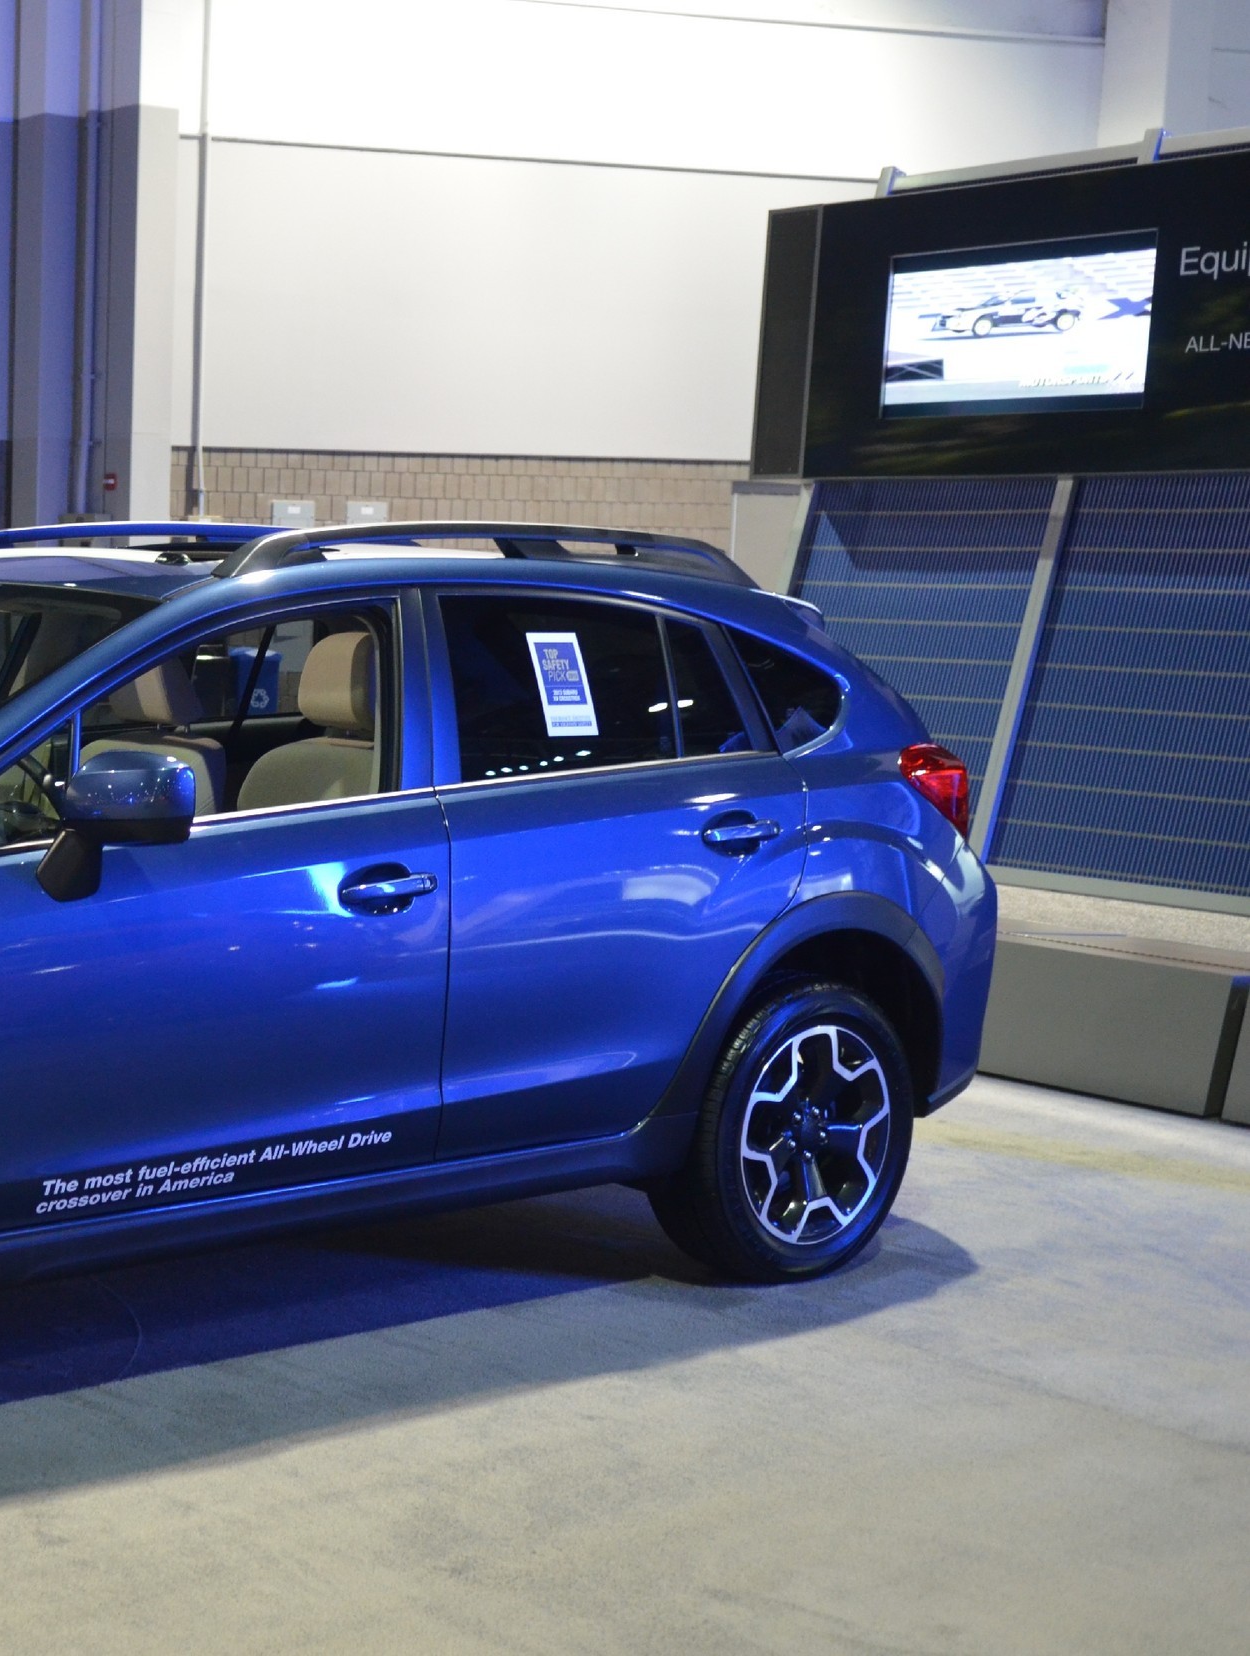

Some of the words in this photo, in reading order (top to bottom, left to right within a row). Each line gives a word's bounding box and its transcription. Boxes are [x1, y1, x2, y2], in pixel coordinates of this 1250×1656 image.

[1180, 241, 1250, 281] Equi
[1185, 332, 1250, 354] ALL-NE
[542, 659, 569, 670] SAFETY
[543, 649, 558, 659] TOP
[43, 1179, 79, 1196] The
[84, 1169, 133, 1190] most
[137, 1150, 256, 1182] fuel-efficient
[259, 1135, 344, 1162] All-Wheel
[348, 1130, 392, 1148] Drive
[35, 1187, 132, 1214] crossover
[135, 1183, 154, 1198] in
[157, 1171, 234, 1194] America
